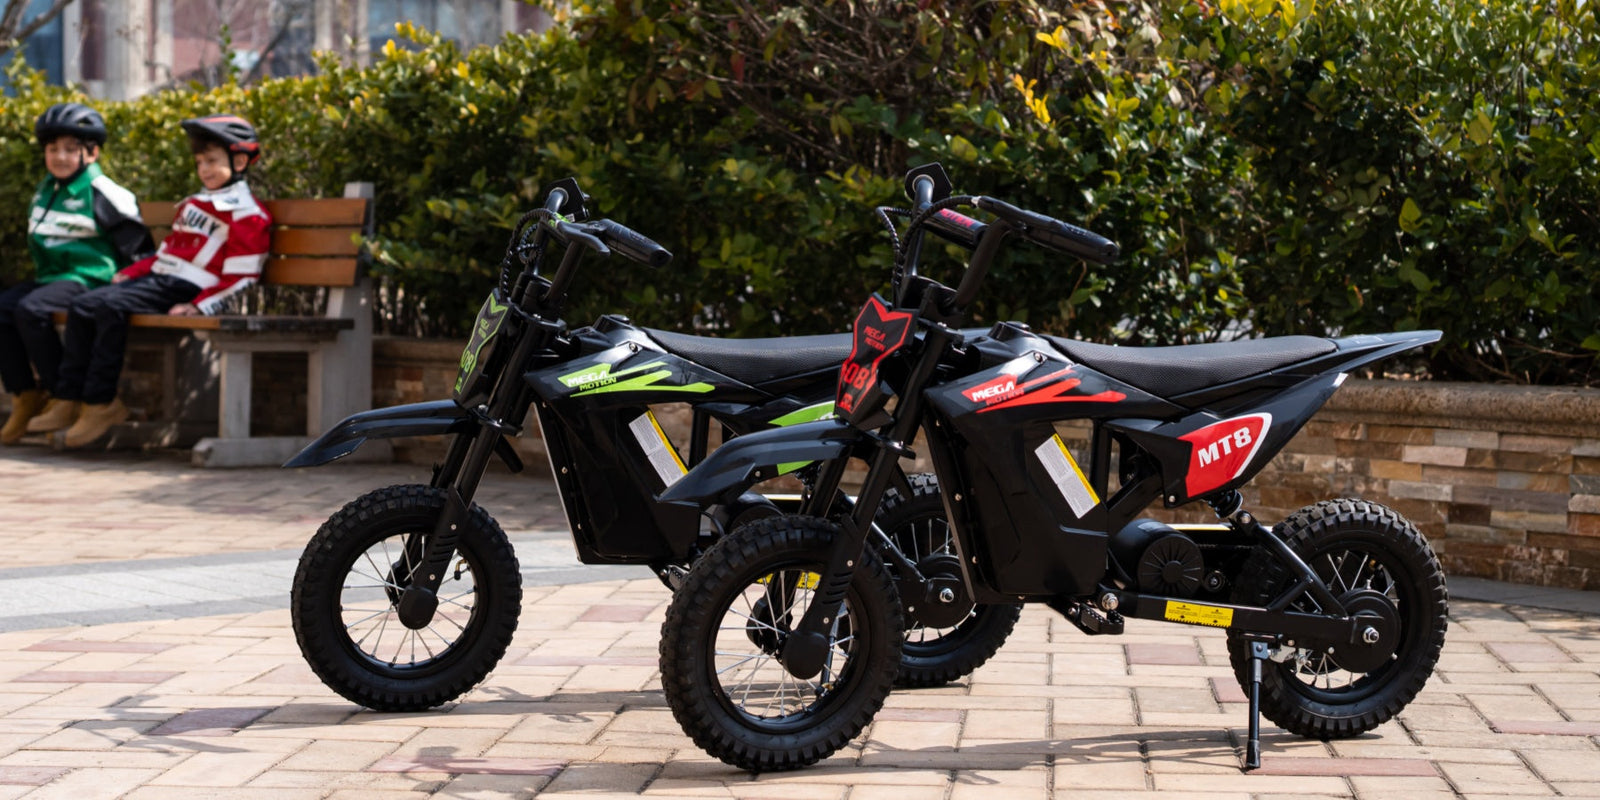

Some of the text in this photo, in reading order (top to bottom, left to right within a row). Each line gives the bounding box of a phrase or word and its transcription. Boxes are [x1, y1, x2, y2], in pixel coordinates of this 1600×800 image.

[863, 325, 886, 342] MEGA
[567, 370, 607, 387] MEGA
[579, 376, 617, 391] MOTION
[972, 381, 1015, 402] MEGA
[1197, 426, 1252, 468] MT8
